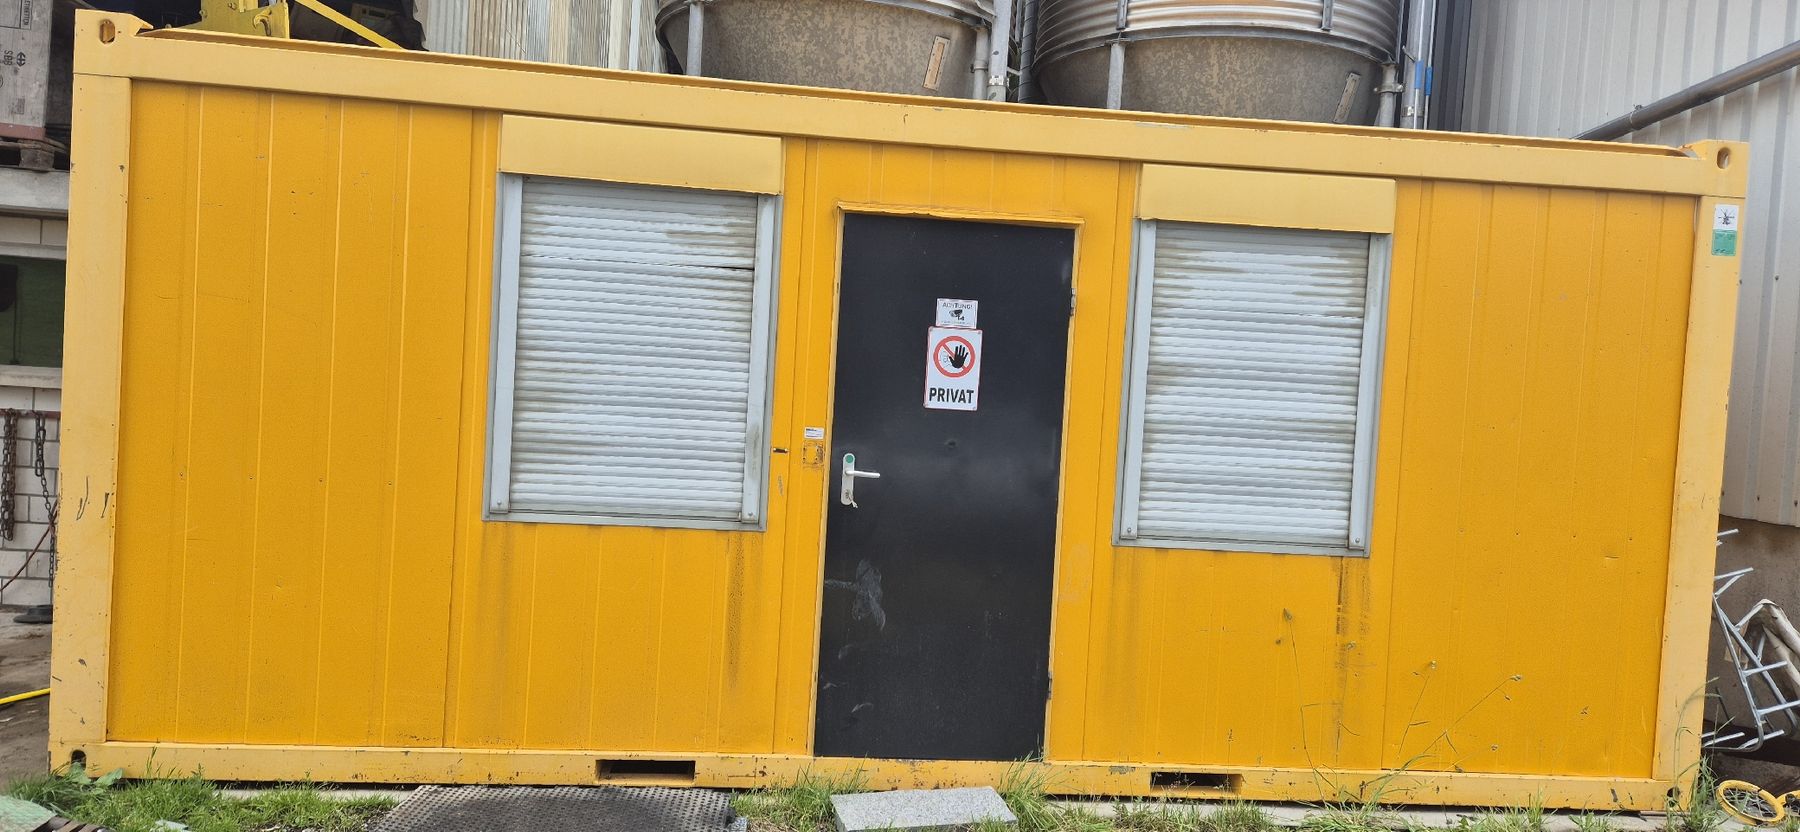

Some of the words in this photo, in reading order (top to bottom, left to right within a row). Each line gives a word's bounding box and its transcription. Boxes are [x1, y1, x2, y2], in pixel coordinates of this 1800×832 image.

[3, 50, 14, 66] SBB
[942, 302, 973, 310] ACHTUNG!
[929, 387, 974, 404] PRIVAT
